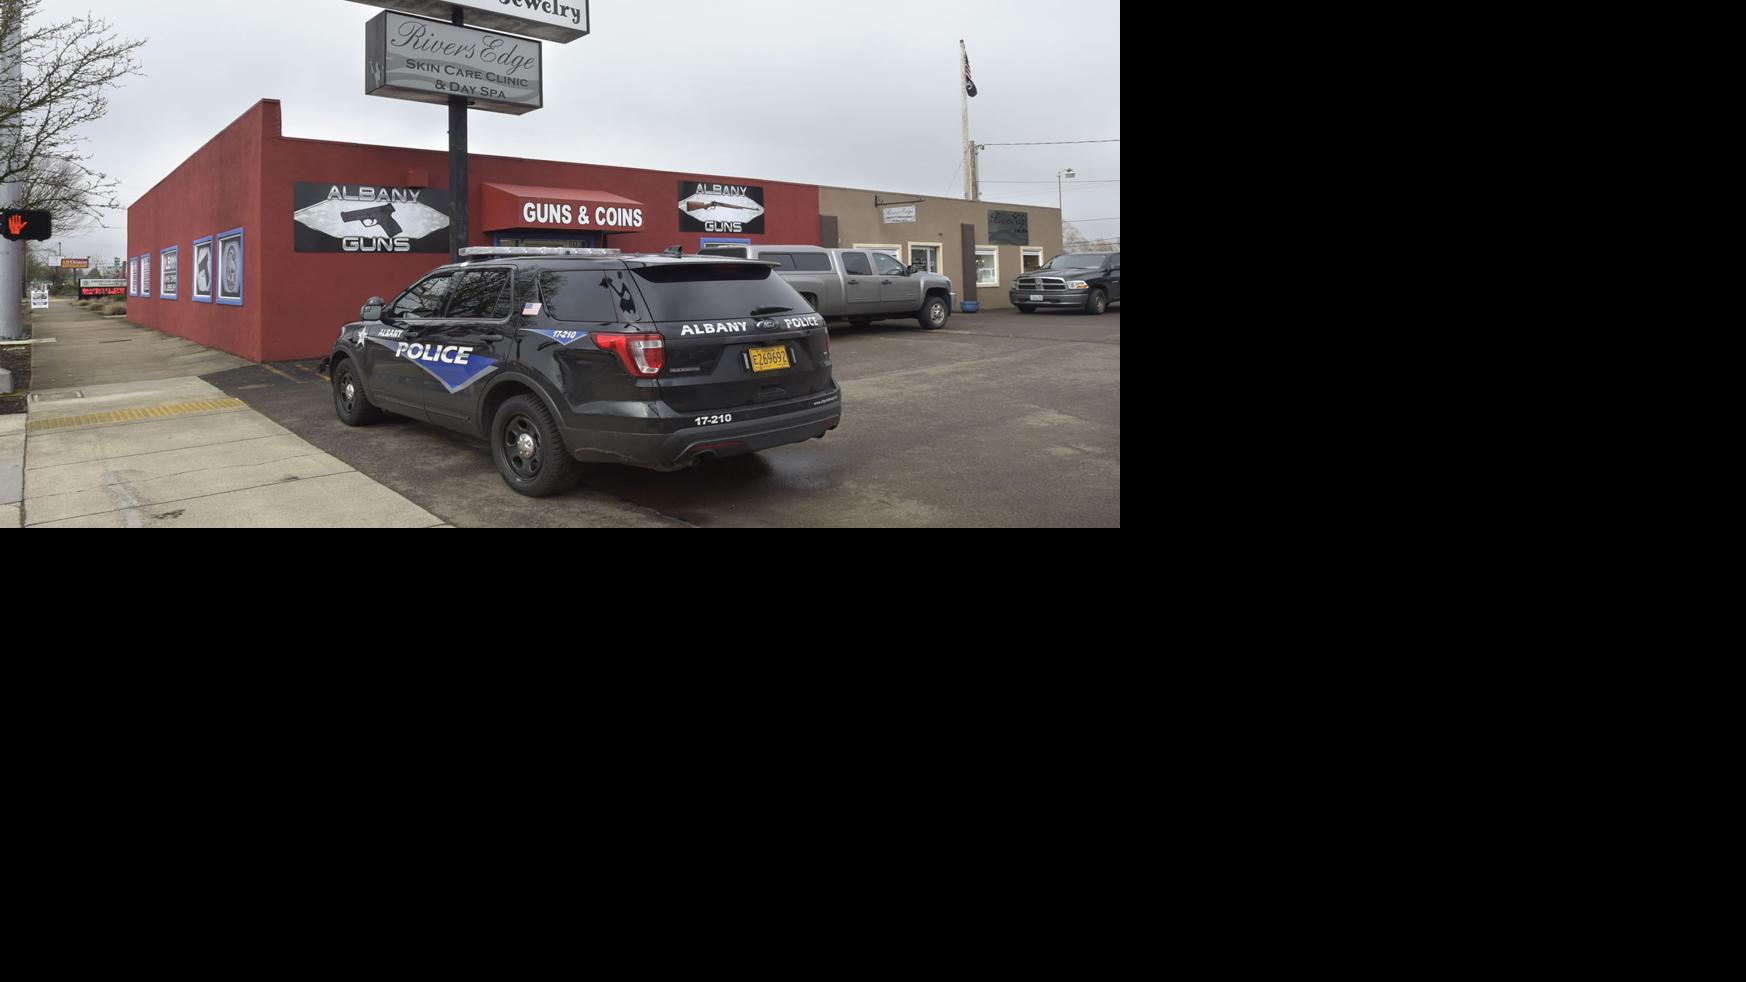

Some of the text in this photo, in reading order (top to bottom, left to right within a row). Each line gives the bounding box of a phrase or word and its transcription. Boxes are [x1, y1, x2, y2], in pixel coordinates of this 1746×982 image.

[499, 0, 581, 25] ewelry
[390, 20, 536, 75] Rivers Edge
[406, 58, 529, 88] SKIN CARE CLINIC
[435, 79, 507, 99] & DAY SPA
[327, 185, 421, 203] ALBANY
[695, 183, 748, 197] ALBANY
[523, 202, 643, 227] GUNS & COINS
[704, 221, 743, 233] GUNS
[342, 236, 411, 252] GUNS
[377, 328, 404, 338] ALBANY
[552, 329, 577, 339] 17-210
[680, 321, 747, 336] ALBANY
[783, 316, 820, 329] POLICE
[395, 341, 473, 365] POLICE
[752, 351, 787, 366] E269692
[694, 413, 732, 426] 17-210
